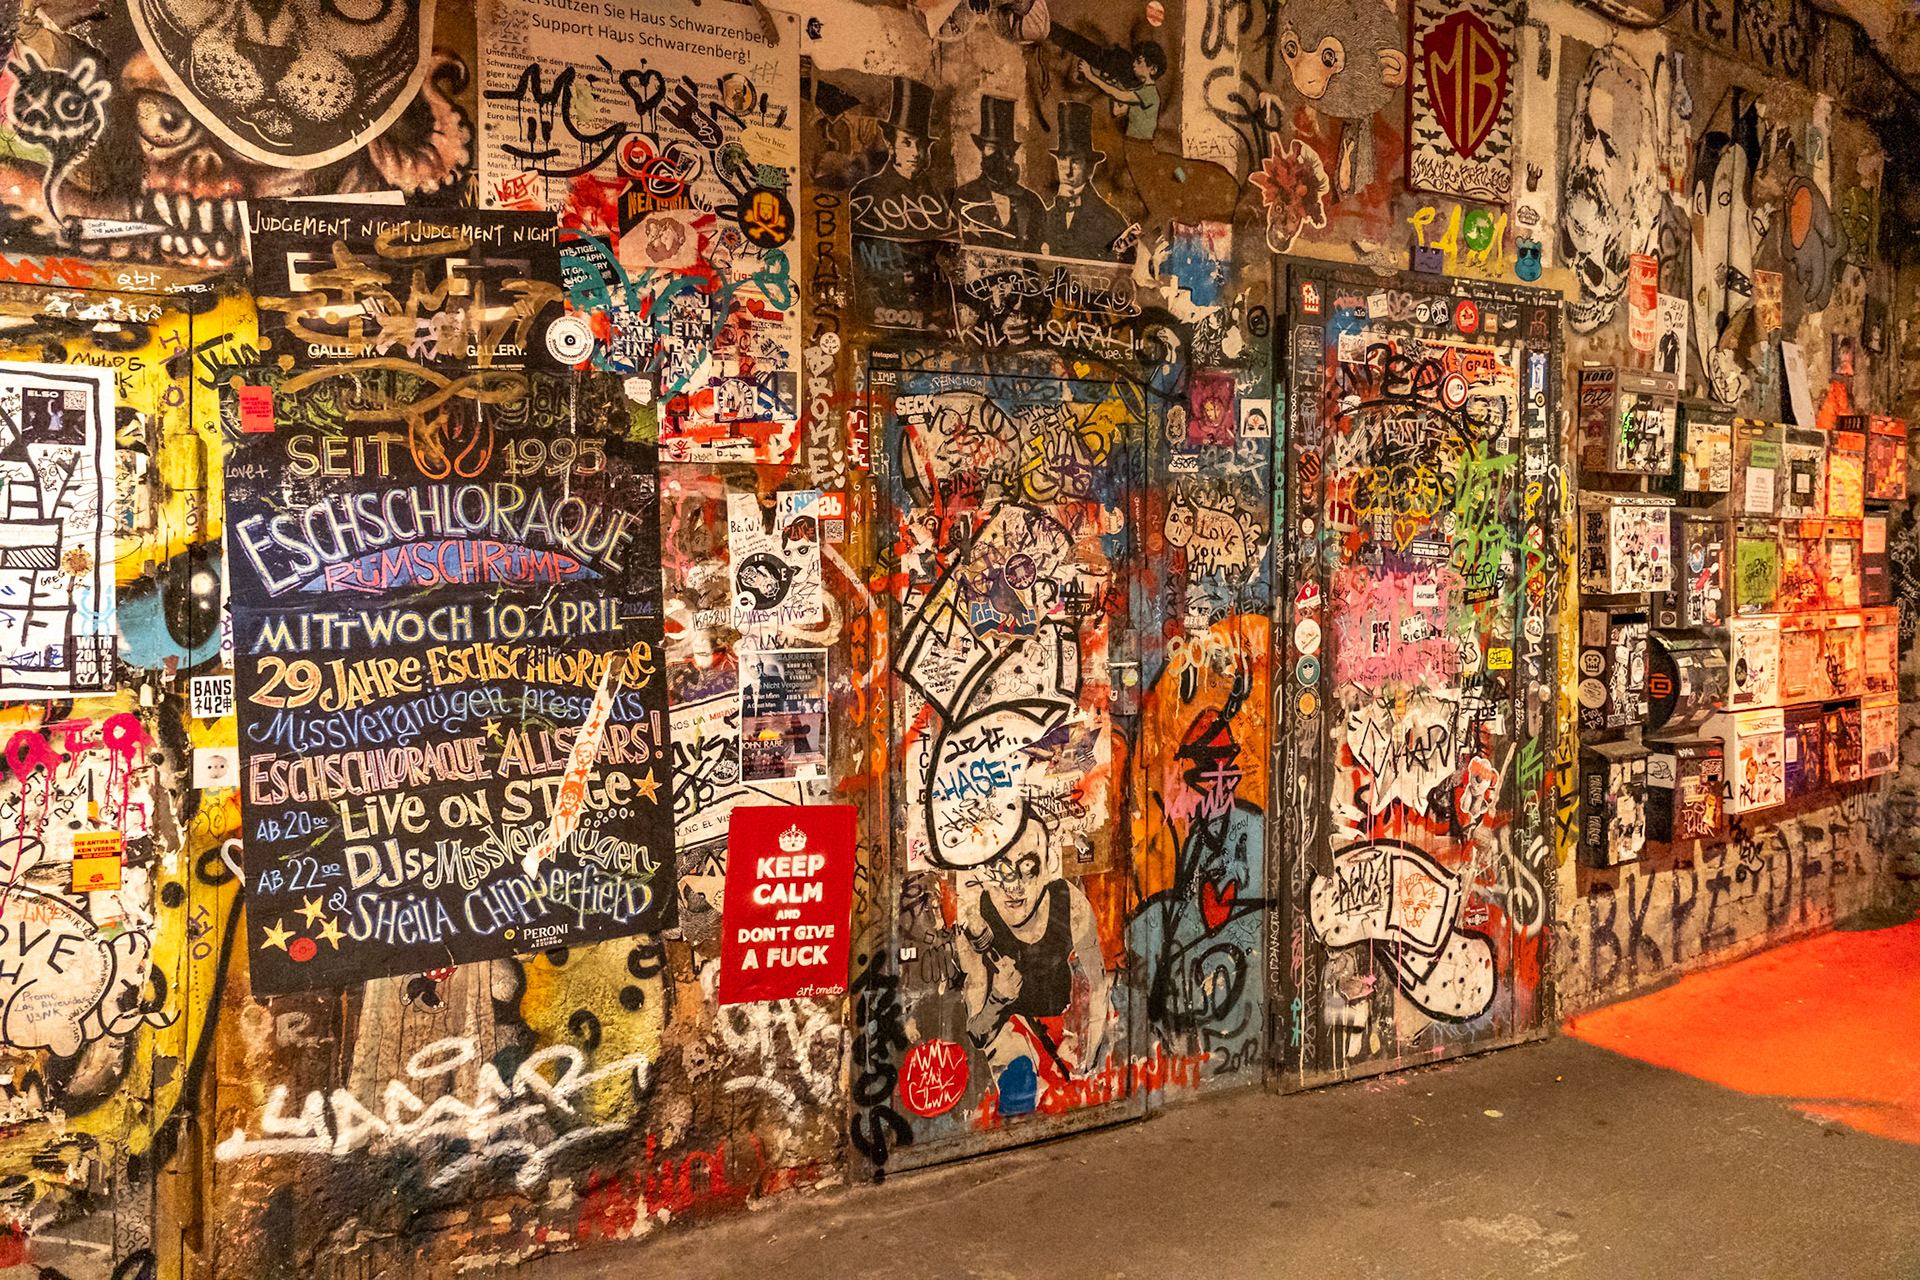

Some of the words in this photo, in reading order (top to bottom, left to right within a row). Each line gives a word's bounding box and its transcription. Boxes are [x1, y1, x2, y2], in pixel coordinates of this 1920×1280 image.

[603, 4, 626, 19] Sie
[630, 6, 666, 27] Haus
[531, 14, 593, 37] Support
[598, 25, 635, 42] Haus
[639, 32, 751, 64] Schwarzenberg!
[485, 48, 535, 61] Unterstützen
[486, 113, 504, 121] Euro
[250, 210, 350, 240] JUDGEMENT
[361, 219, 410, 243] NIGHT
[411, 217, 504, 246] JUDGEMENT
[514, 224, 559, 247] NIGHT
[1583, 371, 1614, 382] KOKO
[286, 432, 403, 478] SEIT
[501, 437, 607, 479] 1995
[236, 482, 643, 598] ESCHSCHLORAQUE
[249, 607, 474, 654] MITTWOCH
[487, 603, 534, 640] 10.
[541, 599, 624, 638] APRIL
[1403, 626, 1428, 642] RICH
[194, 680, 232, 697] BANS
[247, 656, 323, 709] 29
[763, 740, 784, 749] RABE
[248, 736, 493, 806] ESCHSCHLORAQUE
[256, 818, 280, 843] AB
[438, 790, 493, 829] ON
[702, 819, 714, 829] EL
[757, 854, 825, 880] KEEP
[256, 870, 283, 895] AB
[753, 882, 824, 905] CALM
[775, 908, 801, 921] AND
[523, 923, 569, 940] PERONI
[737, 926, 789, 944] DON'T
[793, 925, 835, 940] GIVE
[741, 949, 759, 970] A
[766, 945, 829, 969] FUCK
[22, 991, 58, 1002] Promo
